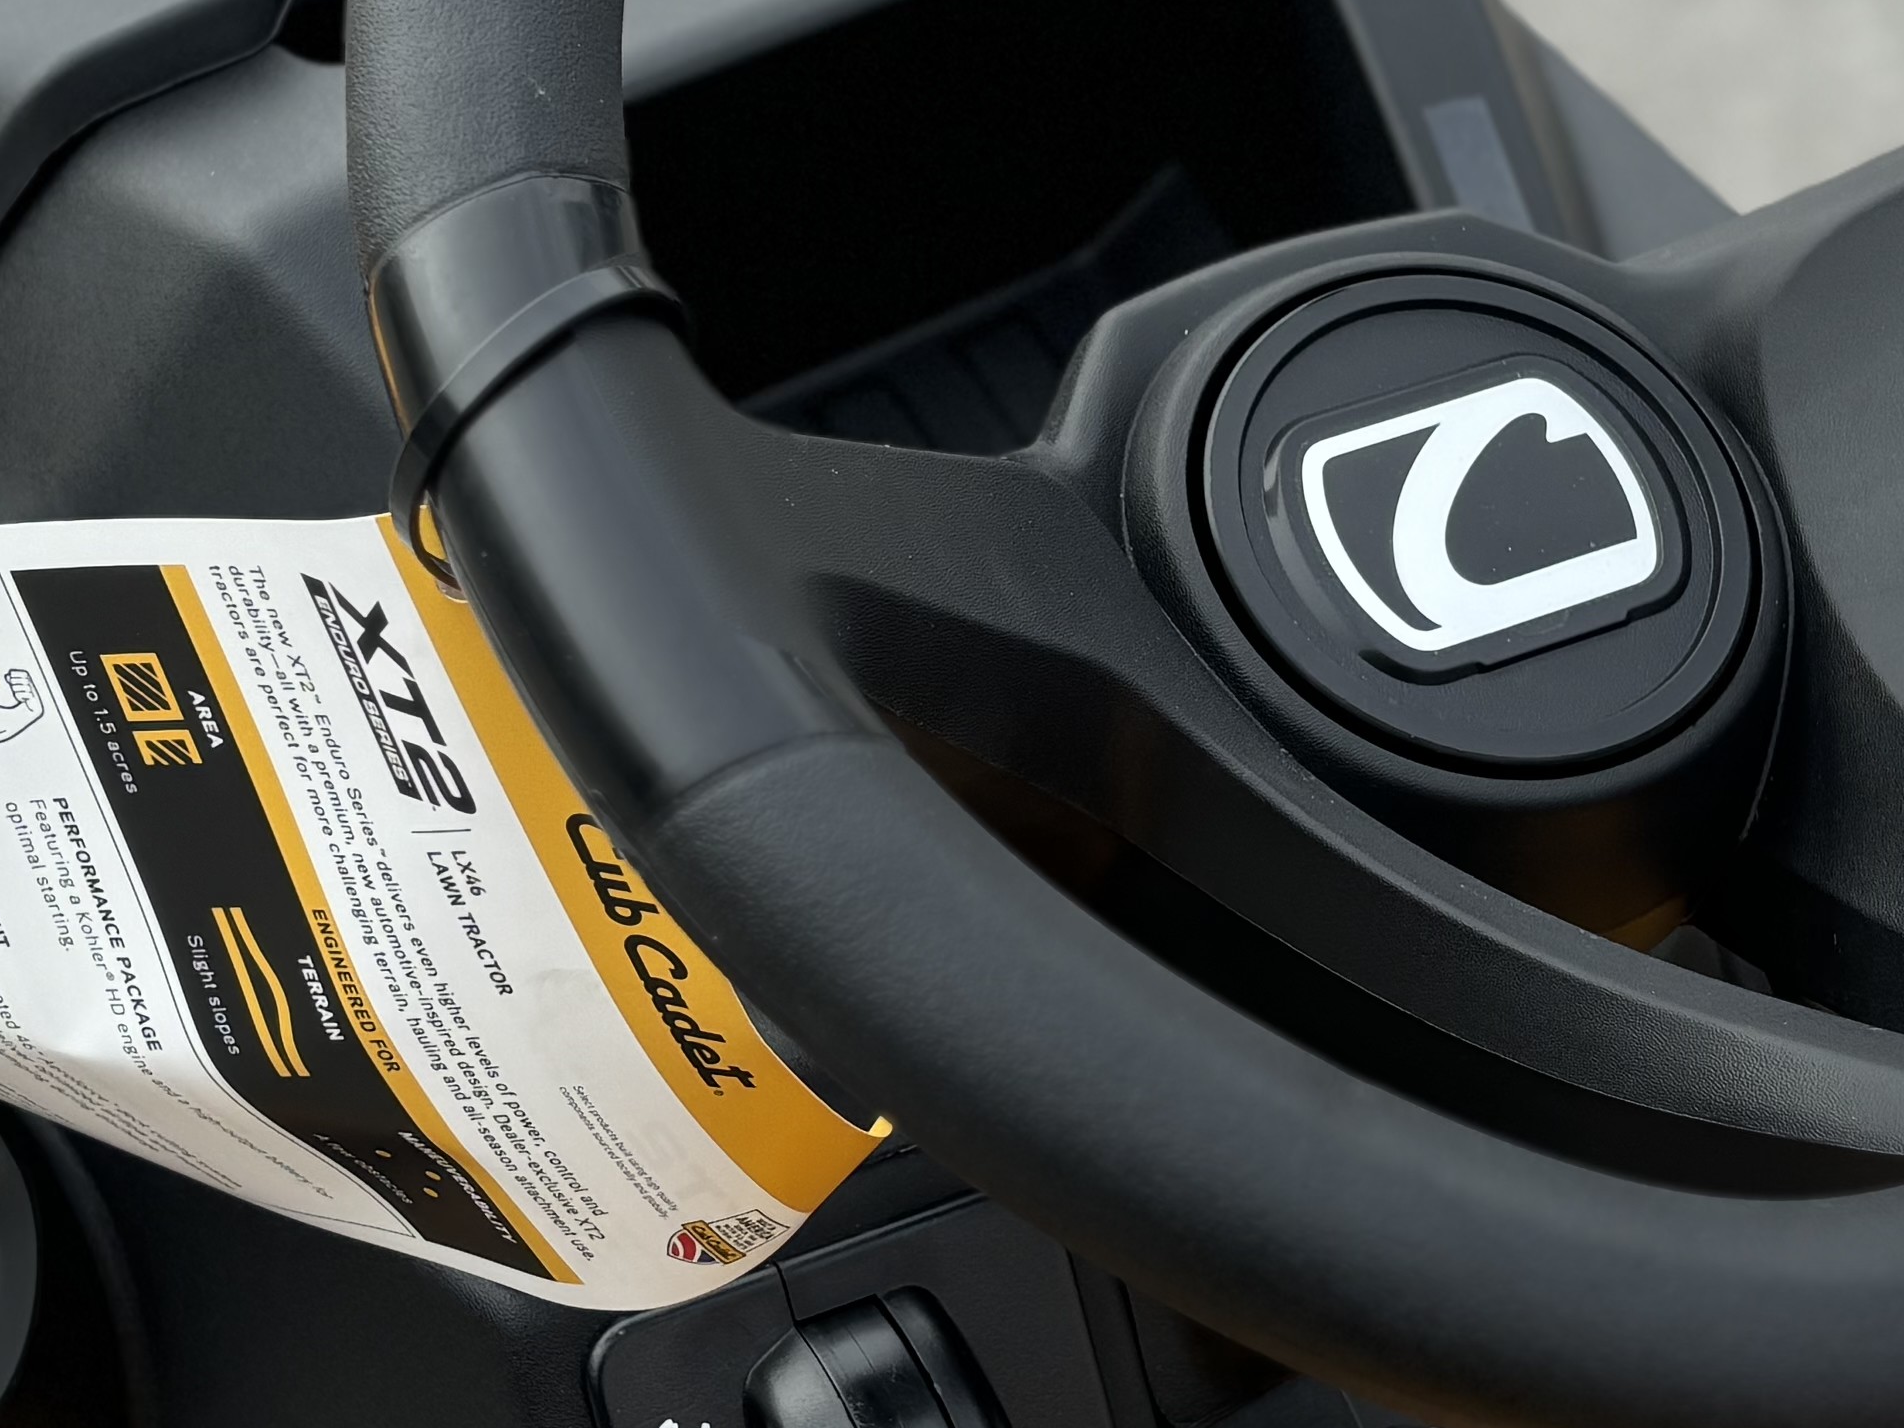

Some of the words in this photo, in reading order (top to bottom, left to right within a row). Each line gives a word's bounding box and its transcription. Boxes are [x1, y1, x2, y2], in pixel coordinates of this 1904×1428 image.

[250, 566, 270, 600] The
[267, 609, 292, 647] new
[316, 594, 365, 697] ENDURO
[69, 650, 88, 677] Up
[83, 683, 98, 703] to
[93, 709, 116, 735] 1.5
[107, 741, 138, 795] acres
[187, 690, 224, 749] AREA
[328, 581, 477, 815] XT2
[315, 713, 350, 780] Enduro
[5, 801, 46, 870] optimal
[36, 876, 75, 953] starting.
[376, 861, 415, 932] delivers
[451, 850, 487, 897] LX46
[566, 813, 660, 926] Cub
[29, 798, 74, 891] Featuring
[70, 894, 80, 904] a
[105, 988, 126, 1017] HD
[117, 1024, 153, 1076] engine
[52, 797, 125, 951] PERFORMANCE
[116, 956, 163, 1052] PACKAGE
[209, 565, 249, 641] tractors
[246, 647, 266, 678] are
[258, 684, 300, 748] perfect
[293, 755, 312, 782] for
[306, 788, 332, 838] more
[328, 843, 379, 946] challenging
[373, 951, 406, 1012] terrain,
[406, 1017, 447, 1071] hauling
[443, 1075, 471, 1102] and
[463, 1104, 519, 1174] all-season
[514, 1174, 577, 1237] attachment
[573, 1239, 595, 1262] use.
[427, 851, 466, 906] LAWN
[458, 912, 513, 996] TRACTOR
[187, 934, 217, 990] Slight
[208, 994, 240, 1056] slopes
[290, 699, 312, 738] with
[307, 744, 319, 754] a
[315, 761, 353, 846] premium,
[352, 852, 377, 892] new
[370, 897, 463, 1058] automotive-inspired
[457, 1061, 494, 1110] design.
[492, 1113, 579, 1218] Dealer-exclusive
[575, 1218, 606, 1242] XT2
[312, 909, 376, 1034] ENGINEERED
[369, 1038, 401, 1072] FOR
[410, 937, 438, 978] even
[298, 954, 344, 1041] TERRAIN
[433, 982, 471, 1032] higher
[466, 1036, 500, 1080] levels
[495, 1082, 517, 1098] of
[503, 1096, 546, 1147] power,
[544, 1149, 588, 1193] control
[581, 1195, 609, 1216] and
